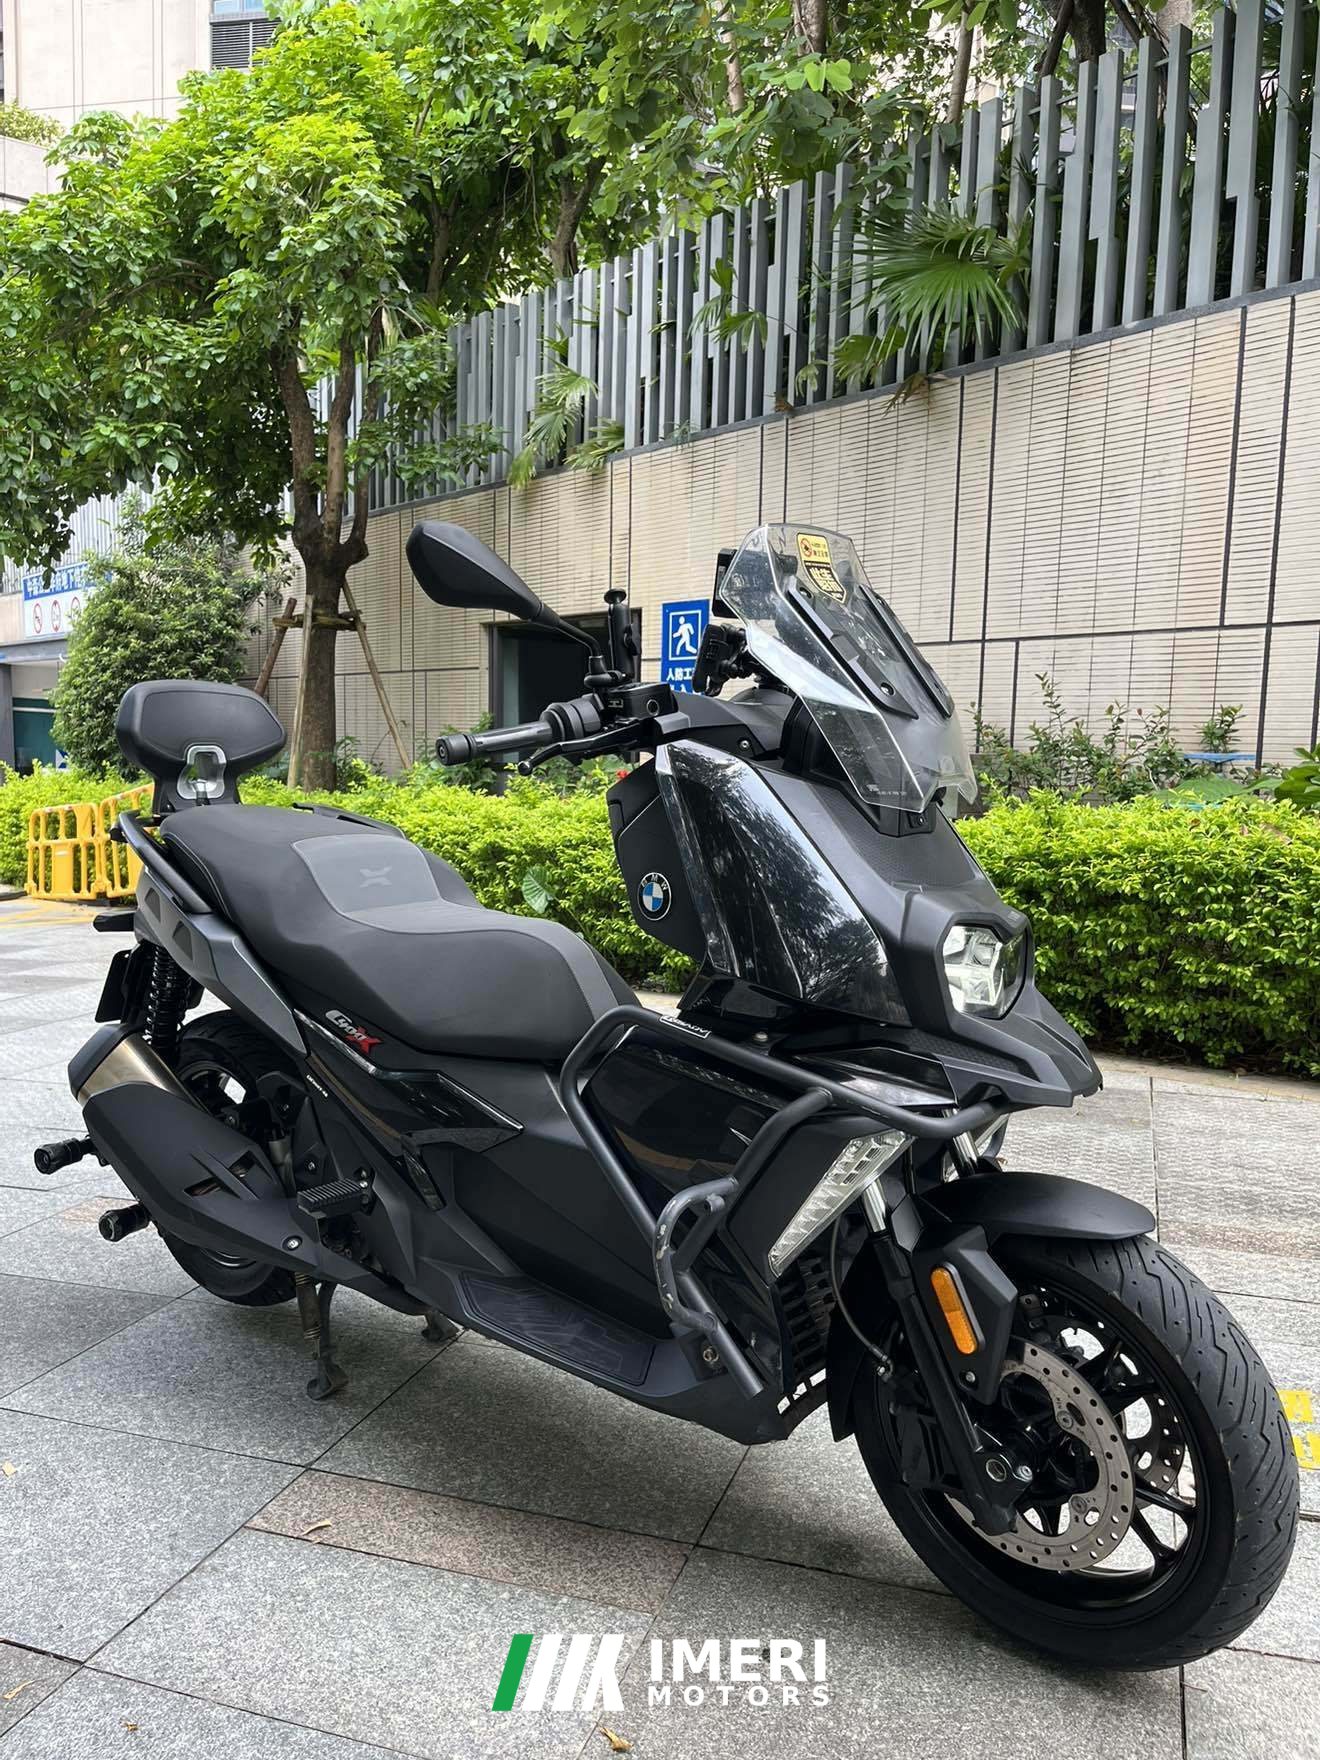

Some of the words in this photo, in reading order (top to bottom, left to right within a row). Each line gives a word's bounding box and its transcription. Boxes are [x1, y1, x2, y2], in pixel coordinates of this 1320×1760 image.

[666, 667, 695, 681] 人防工
[641, 874, 669, 891] BMW
